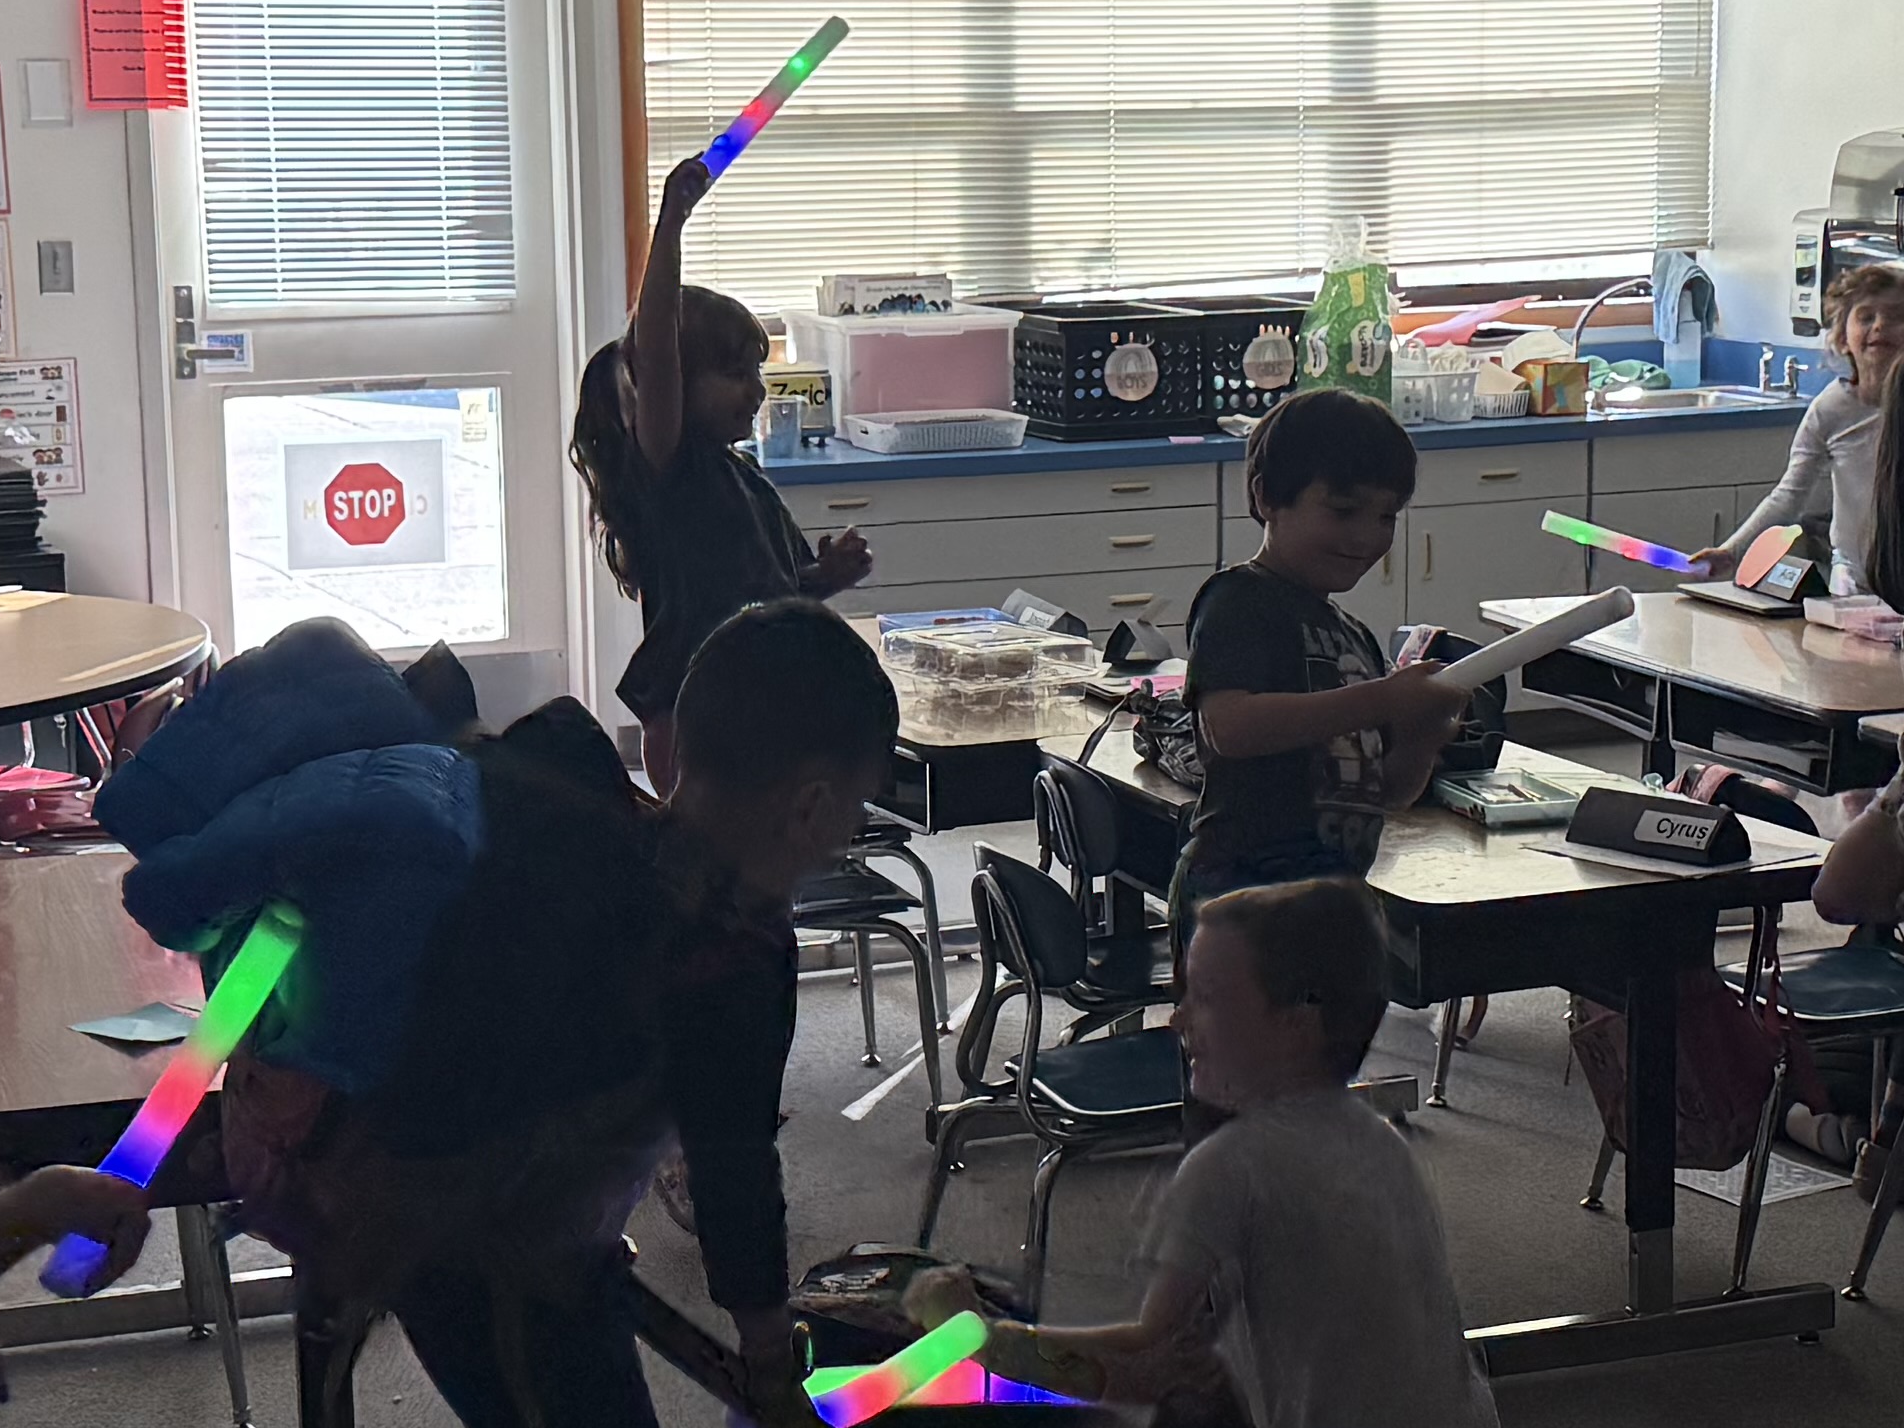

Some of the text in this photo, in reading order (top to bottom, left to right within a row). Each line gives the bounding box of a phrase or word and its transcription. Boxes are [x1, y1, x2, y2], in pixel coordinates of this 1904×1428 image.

[1117, 374, 1148, 390] BOYS
[334, 489, 396, 520] STOP
[1657, 818, 1709, 839] Cyrus
